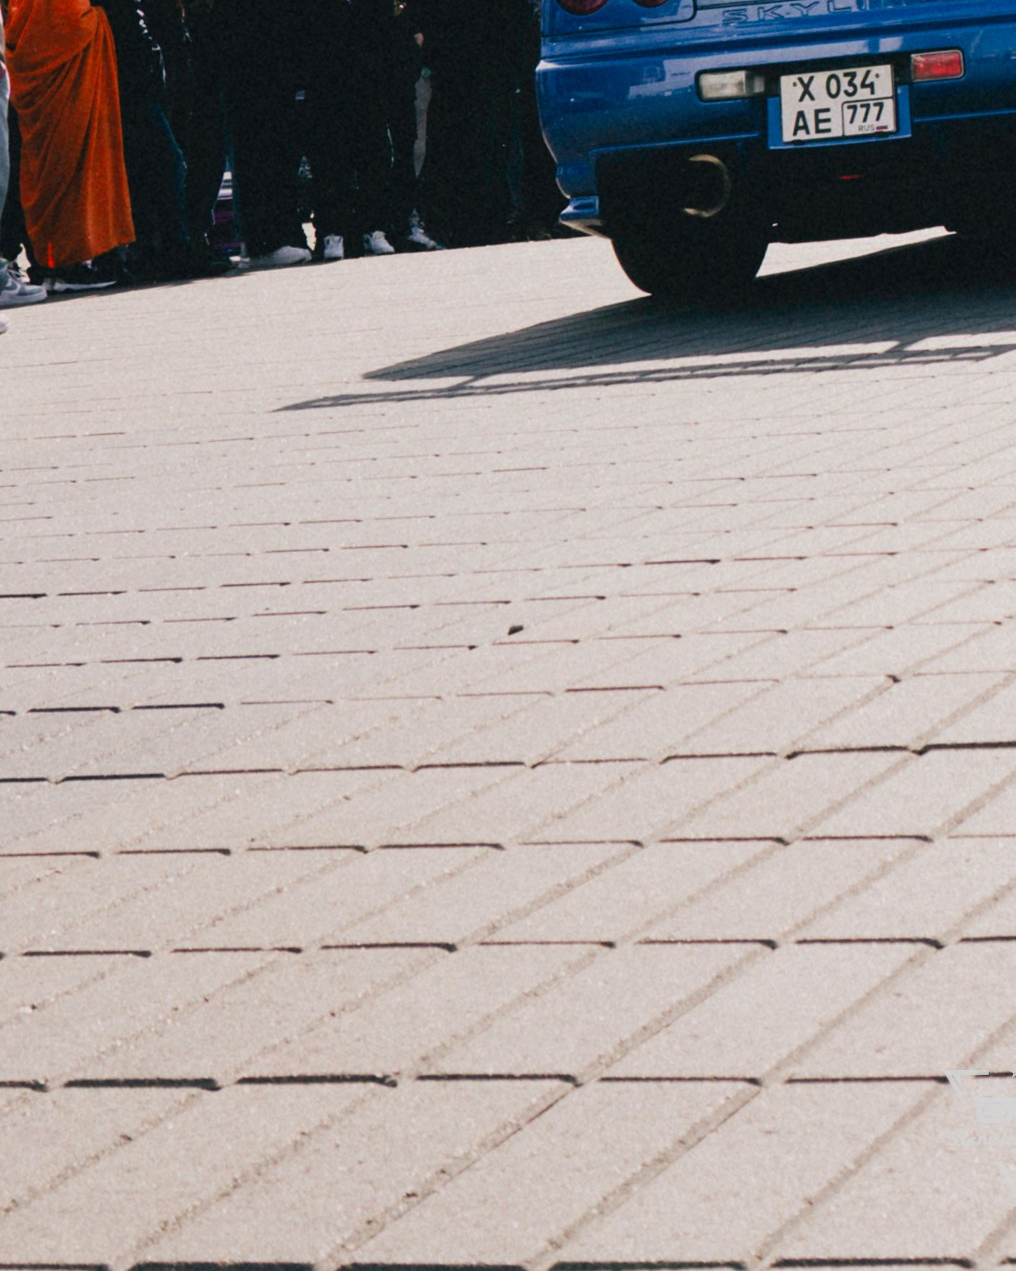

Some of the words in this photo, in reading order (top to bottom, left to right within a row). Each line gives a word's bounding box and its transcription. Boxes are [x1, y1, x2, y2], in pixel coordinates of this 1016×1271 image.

[826, 69, 875, 100] 034
[846, 101, 885, 125] 777
[858, 124, 875, 132] RUS
